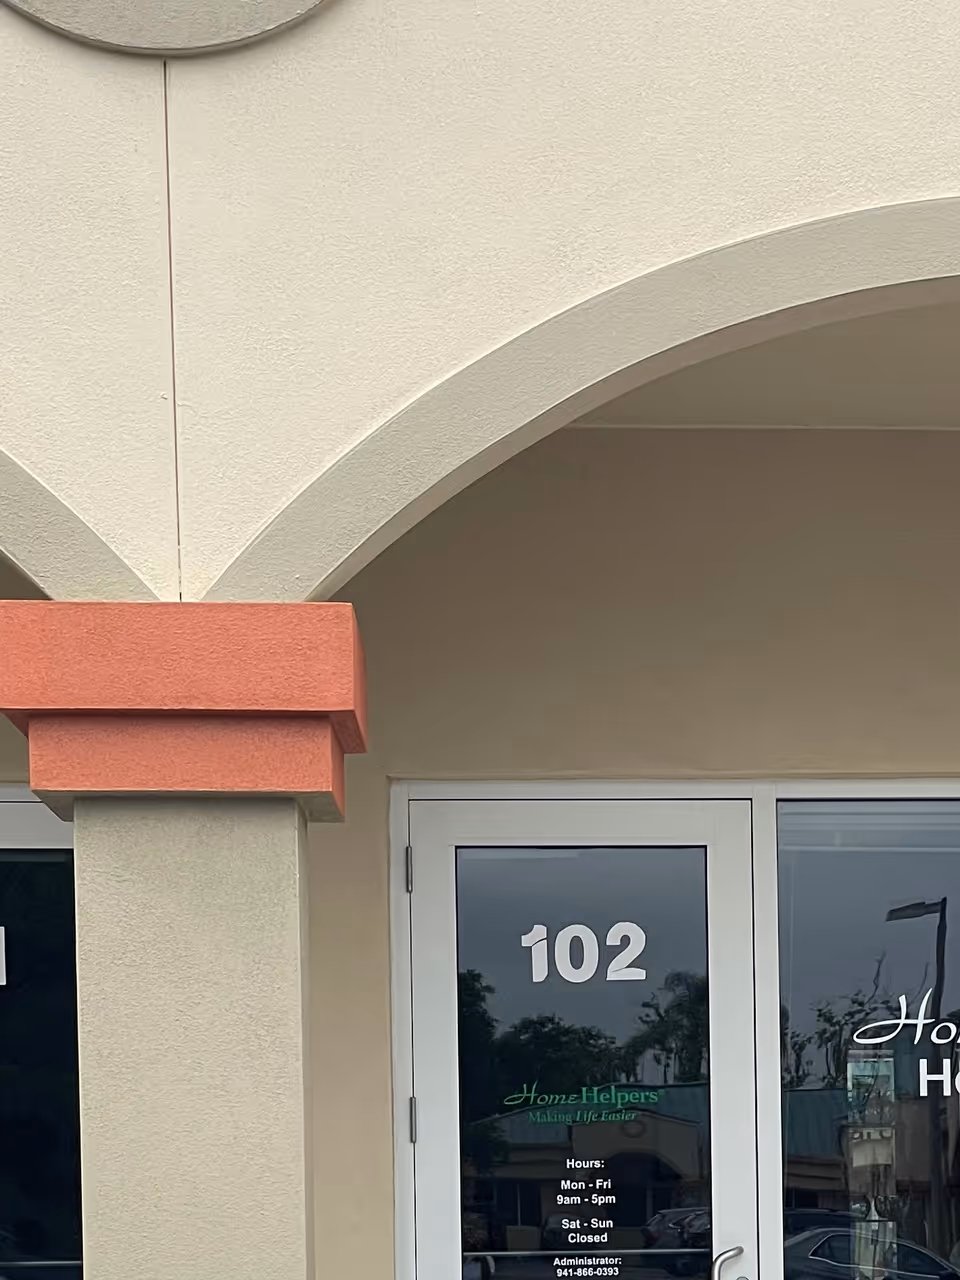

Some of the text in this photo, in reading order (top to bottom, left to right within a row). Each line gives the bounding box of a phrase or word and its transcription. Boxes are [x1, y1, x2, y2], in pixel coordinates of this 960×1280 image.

[521, 921, 647, 983] 102
[504, 1080, 580, 1105] Home
[528, 1109, 637, 1125] Making Life Easier
[566, 1158, 605, 1169] Hours:
[560, 1180, 586, 1190] Mon
[595, 1179, 612, 1190] Fri
[556, 1195, 581, 1205] 9am
[591, 1194, 616, 1206] 5pm
[561, 1219, 581, 1229] Sat
[590, 1218, 614, 1229] Sun
[567, 1232, 608, 1243] Closed
[553, 1257, 622, 1266] Administrator:
[556, 1267, 620, 1277] 941-866-0393
